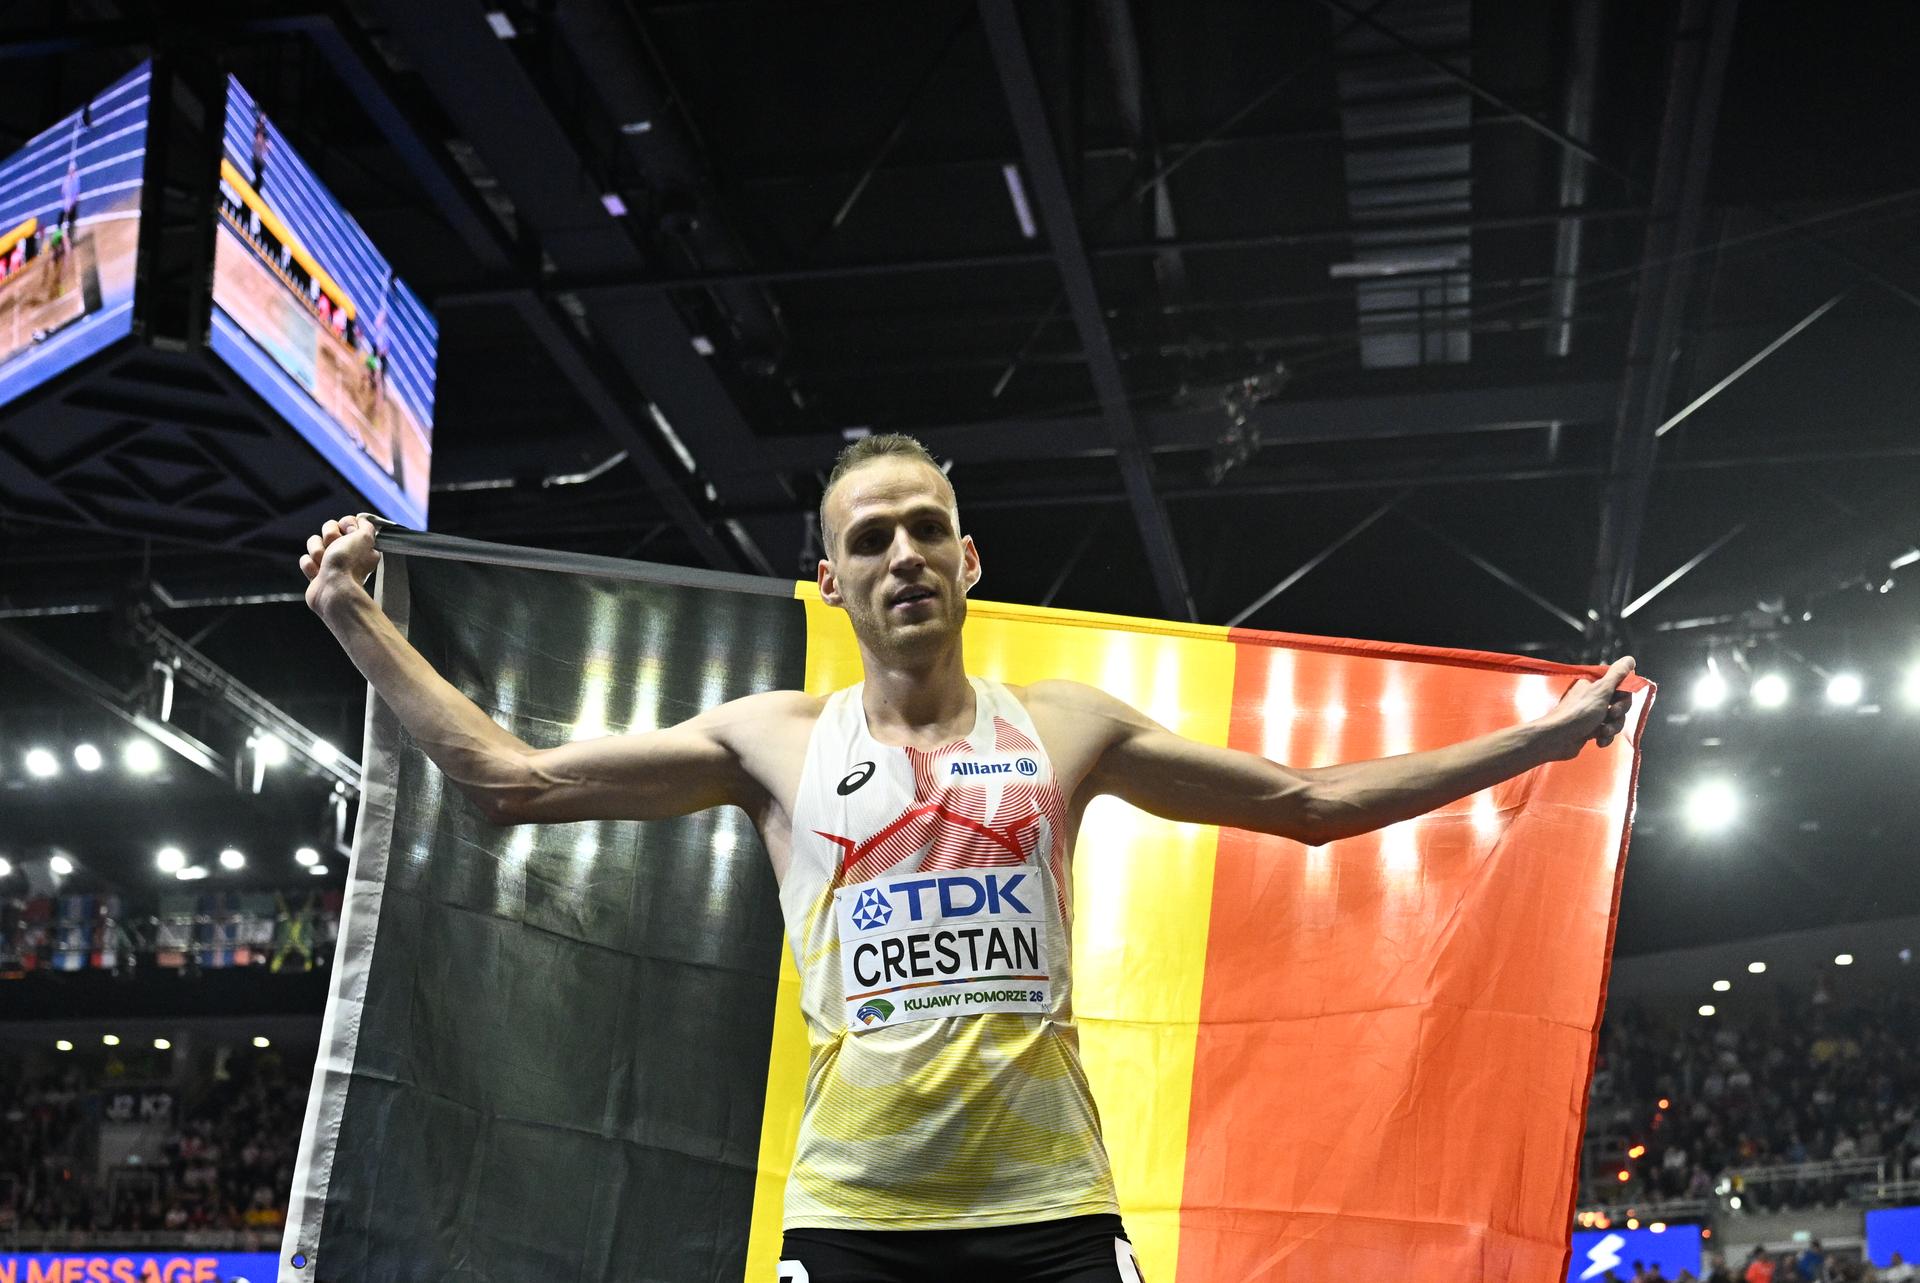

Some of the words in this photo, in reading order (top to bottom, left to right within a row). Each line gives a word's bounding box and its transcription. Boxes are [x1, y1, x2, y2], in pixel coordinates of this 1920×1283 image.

[951, 762, 1012, 775] Allianz
[889, 874, 1032, 921] TDK
[853, 927, 1039, 987] CRESTAN
[904, 994, 961, 1011] KUJAWY
[965, 991, 1027, 1004] POMORZE
[1029, 991, 1043, 1002] 26
[27, 1257, 218, 1283] MESSAGE
